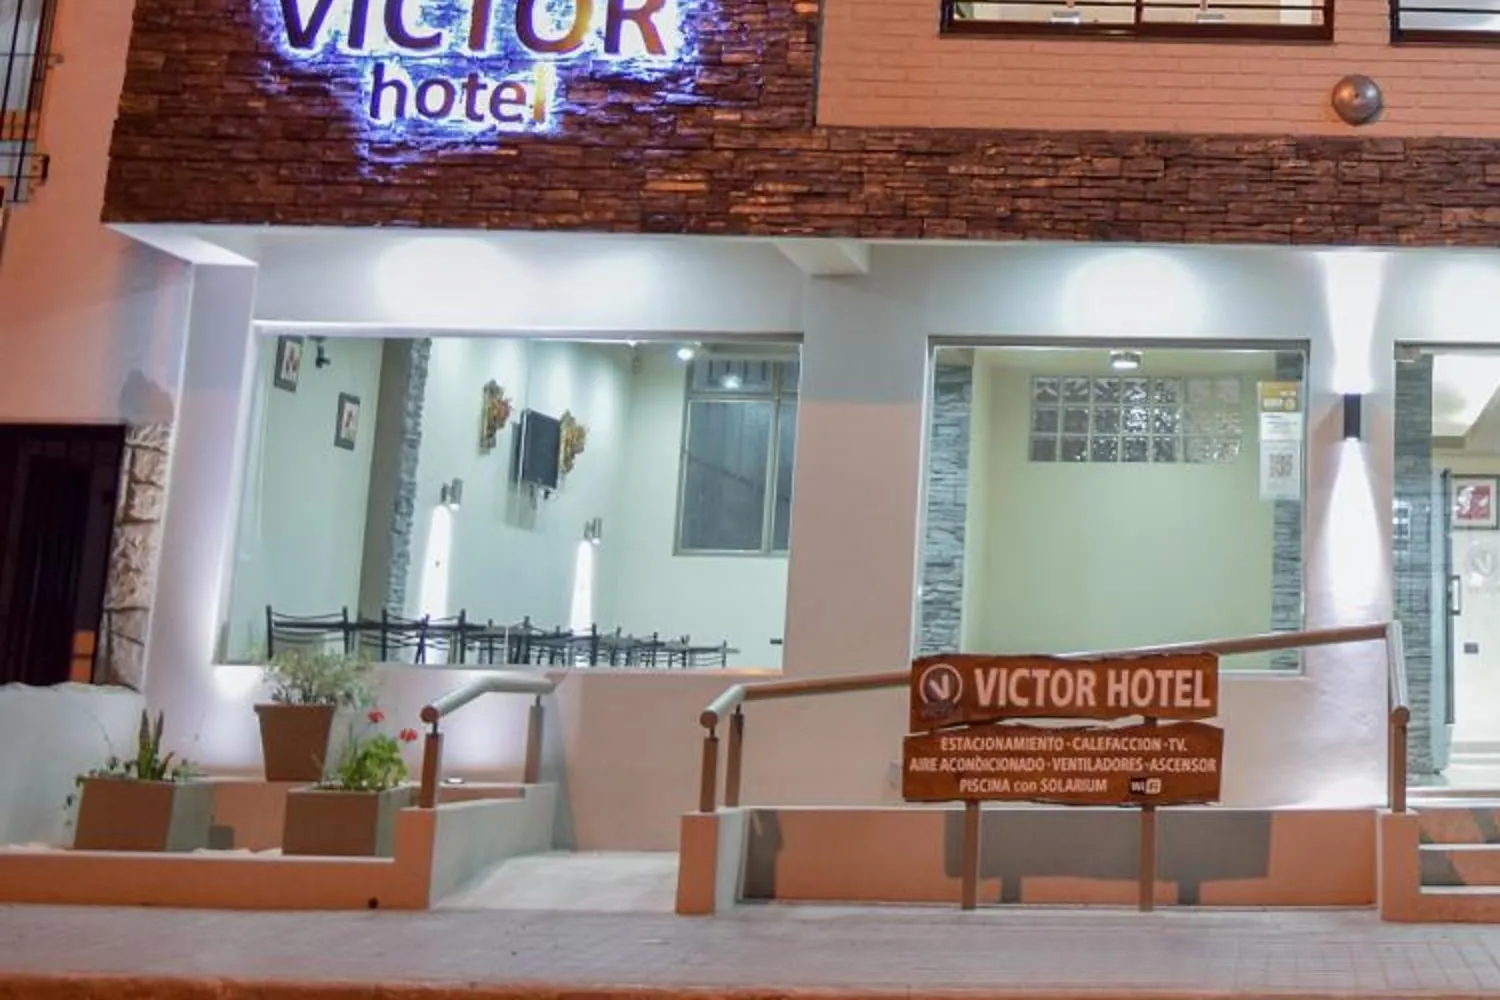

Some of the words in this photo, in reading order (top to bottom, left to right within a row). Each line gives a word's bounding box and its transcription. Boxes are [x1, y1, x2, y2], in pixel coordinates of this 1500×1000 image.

[370, 62, 545, 123] hotel
[974, 667, 1097, 707] VICTOR
[1107, 668, 1211, 708] HOTEL
[941, 736, 1064, 751] ESTACIONAMIENTO
[1072, 737, 1161, 751] CALEFACCION
[909, 757, 938, 771] AIRE
[940, 756, 1045, 772] ACONDICIONADO
[1052, 757, 1143, 771] VENTILADORES
[1150, 758, 1217, 772] ASCENSOR
[960, 778, 1011, 792] PISCINA
[1014, 780, 1037, 793] con
[1040, 778, 1107, 792] SOLARIUM
